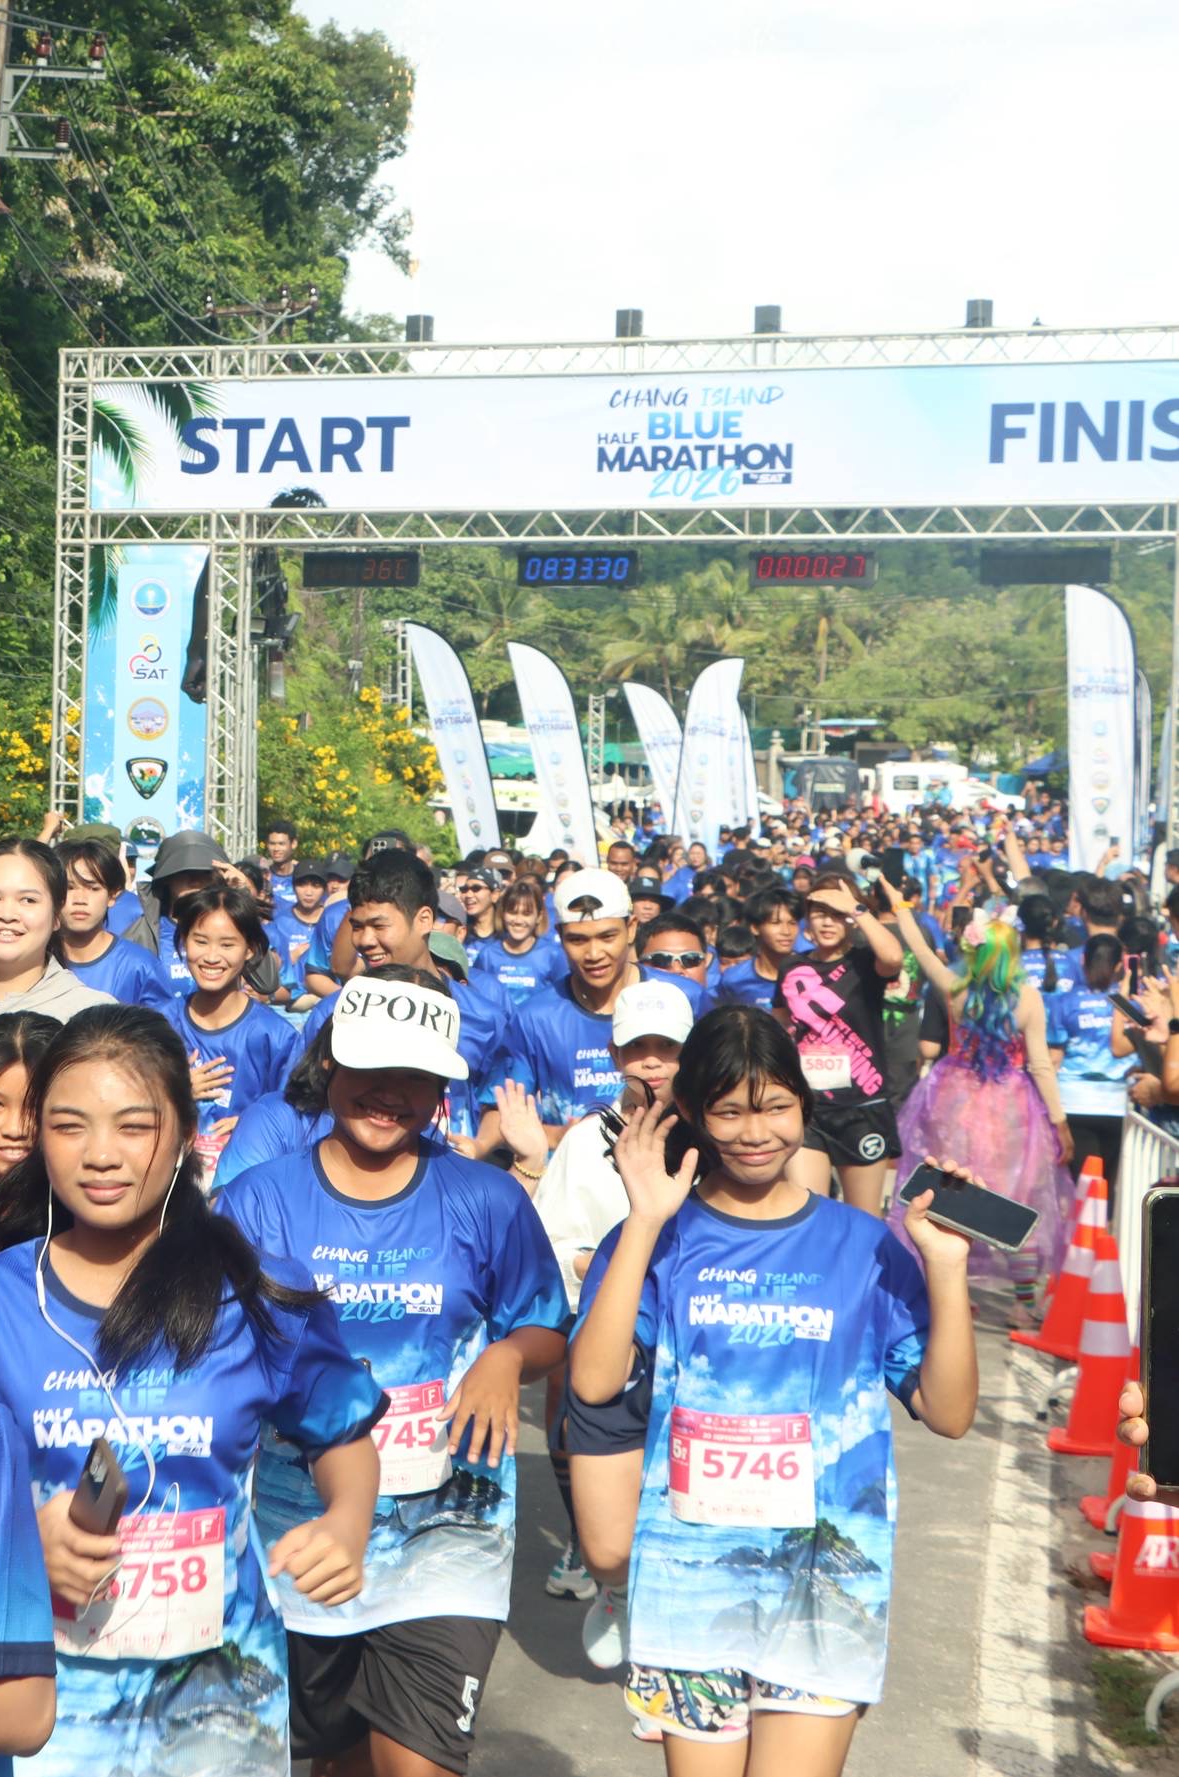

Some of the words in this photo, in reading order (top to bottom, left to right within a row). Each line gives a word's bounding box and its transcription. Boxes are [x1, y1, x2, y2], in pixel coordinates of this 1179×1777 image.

[610, 387, 688, 408] CHANG
[701, 386, 784, 406] ISLAND
[648, 411, 743, 439] BLUE
[181, 416, 410, 475] START
[597, 432, 639, 444] HALF
[597, 443, 793, 472] MARATHON
[649, 465, 741, 501] 2026
[133, 668, 168, 680] SAT
[341, 990, 456, 1039] SPORT
[804, 1058, 845, 1071] 5807
[574, 1072, 623, 1088] MARAT
[312, 1245, 370, 1263] CHANG
[376, 1248, 433, 1262] ISLAND
[339, 1263, 407, 1280] BLUE
[698, 1268, 757, 1284] CHANG
[764, 1272, 824, 1285] ISLAND
[690, 1294, 722, 1305] HALF
[725, 1282, 797, 1299] BLUE
[340, 1301, 406, 1323] 2026
[689, 1303, 834, 1331] MARATHON
[727, 1324, 796, 1348] 2026
[428, 1389, 437, 1404] F
[33, 1408, 74, 1424] HALF
[34, 1416, 214, 1449] MARATHON
[792, 1423, 804, 1438] F
[702, 1449, 800, 1480] 5746
[201, 1519, 214, 1539] F
